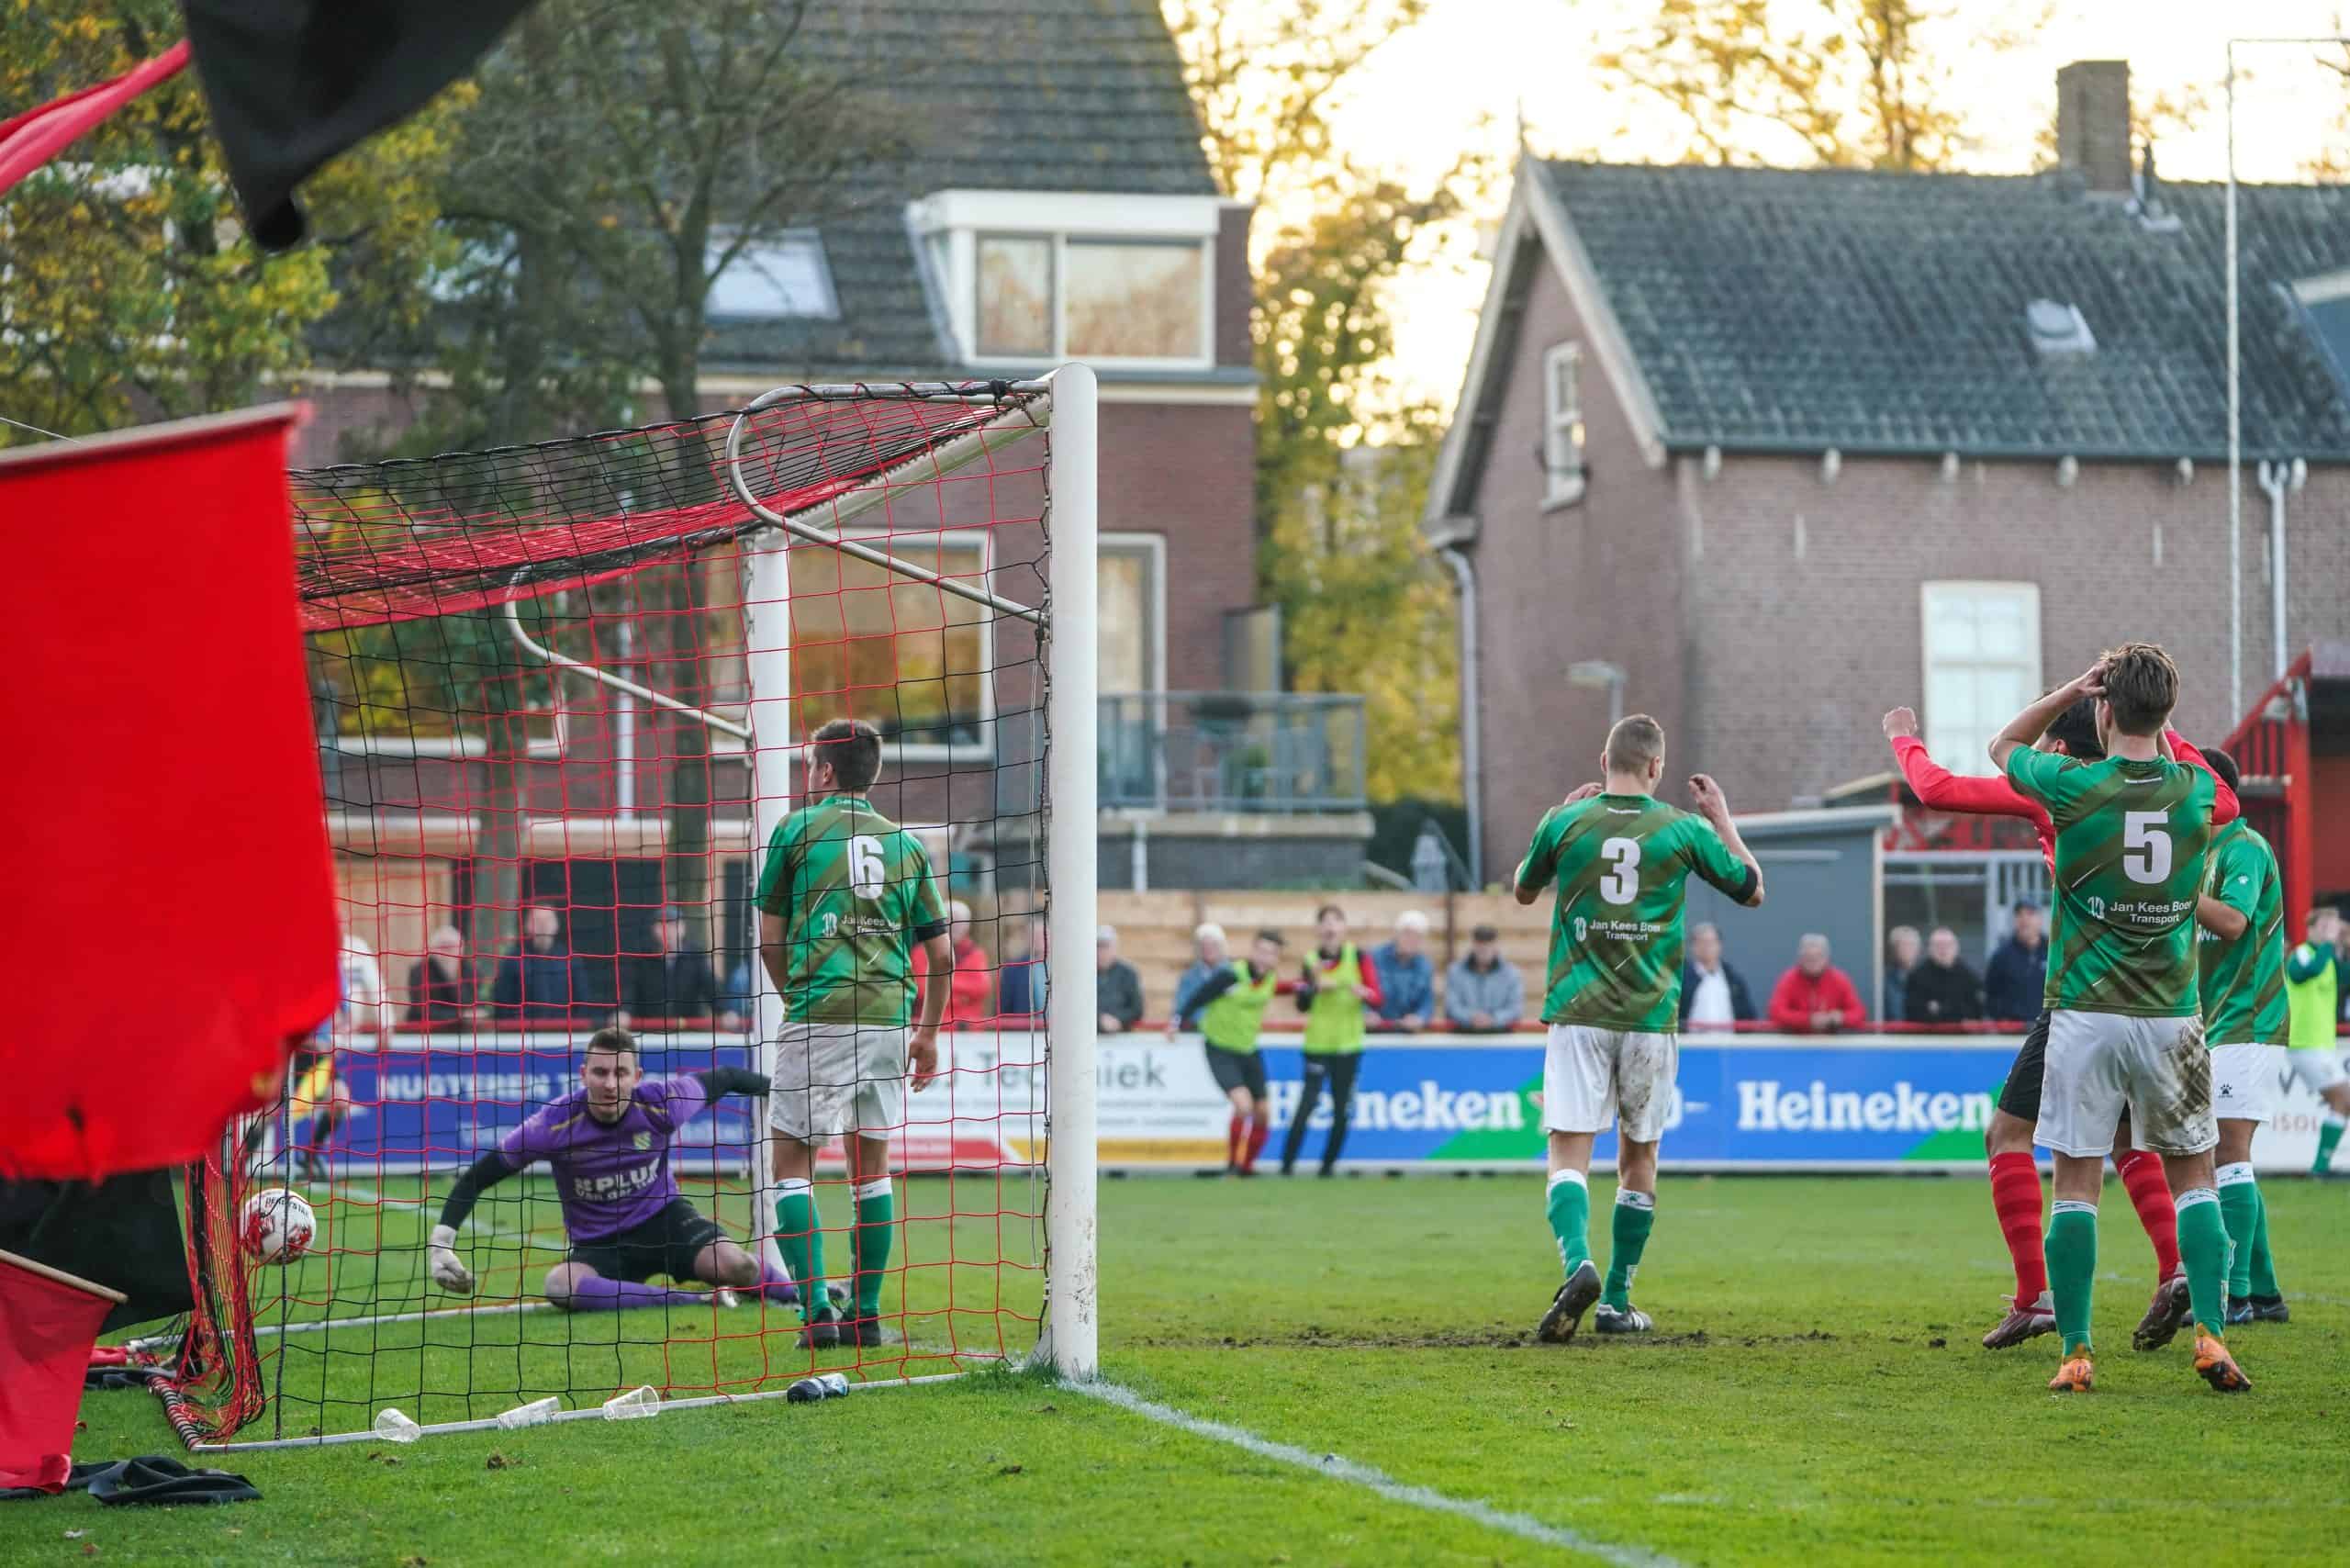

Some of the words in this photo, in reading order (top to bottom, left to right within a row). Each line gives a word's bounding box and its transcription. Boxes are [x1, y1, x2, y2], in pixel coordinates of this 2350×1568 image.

[846, 834, 886, 901] 6
[1600, 836, 1641, 905] 3
[2123, 811, 2173, 885] 5
[1590, 919, 1608, 931] Jan
[1610, 920, 1639, 932] Kees
[2110, 902, 2134, 913] Jan
[2138, 902, 2170, 913] Kees
[2130, 913, 2180, 925] Transport
[976, 1051, 1169, 1090] Tecniek
[1265, 1079, 1526, 1130] Heneken
[1736, 1080, 1994, 1132] Heineken
